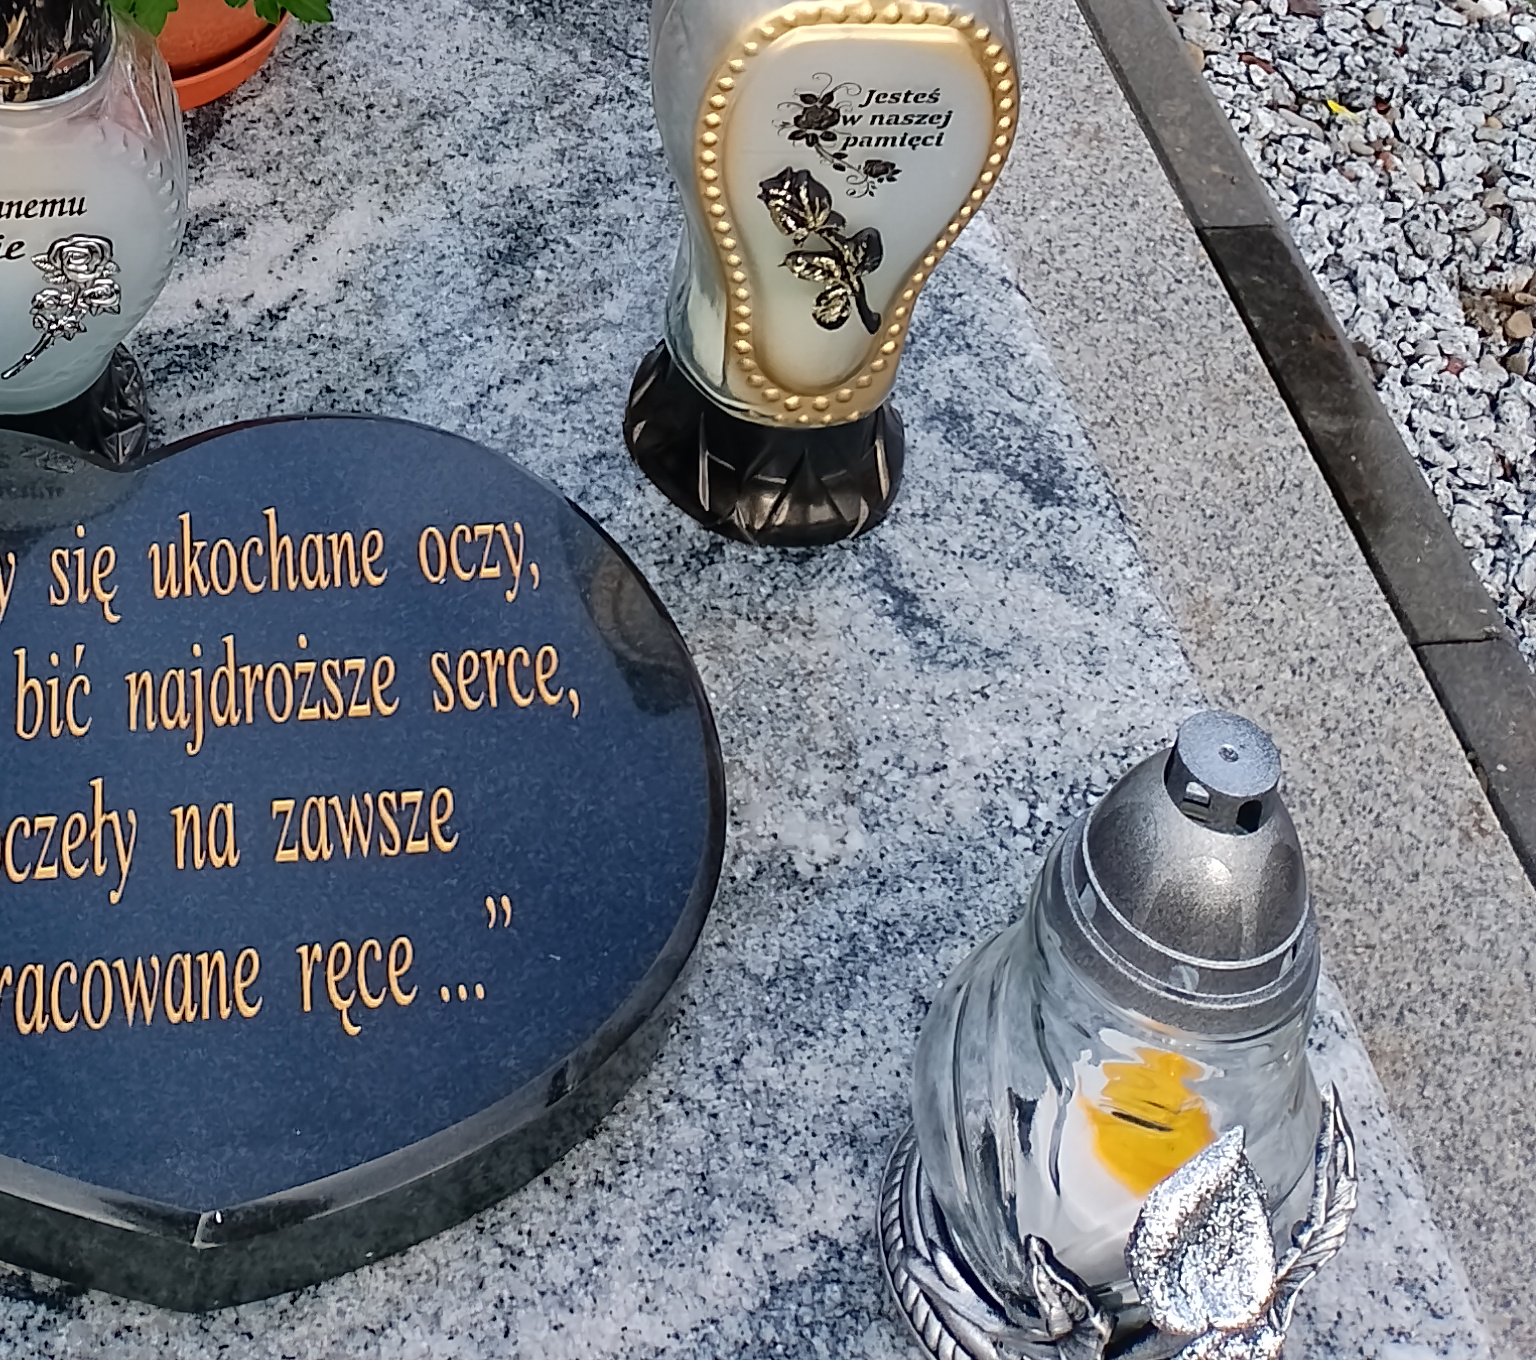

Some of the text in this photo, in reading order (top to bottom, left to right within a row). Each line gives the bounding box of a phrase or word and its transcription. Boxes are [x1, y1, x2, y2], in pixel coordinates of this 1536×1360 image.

[842, 110, 953, 129] w naszej
[858, 88, 940, 108] Jesteś
[841, 132, 944, 150] pamięci
[50, 525, 119, 623] się
[148, 508, 386, 599] ukochane
[419, 522, 542, 602] oczy,
[14, 645, 91, 740] bić
[126, 635, 399, 756] najdroższe
[431, 642, 581, 718] serce,
[171, 803, 238, 870] na
[271, 786, 458, 863] zawsze
[298, 937, 417, 1036] ręce
